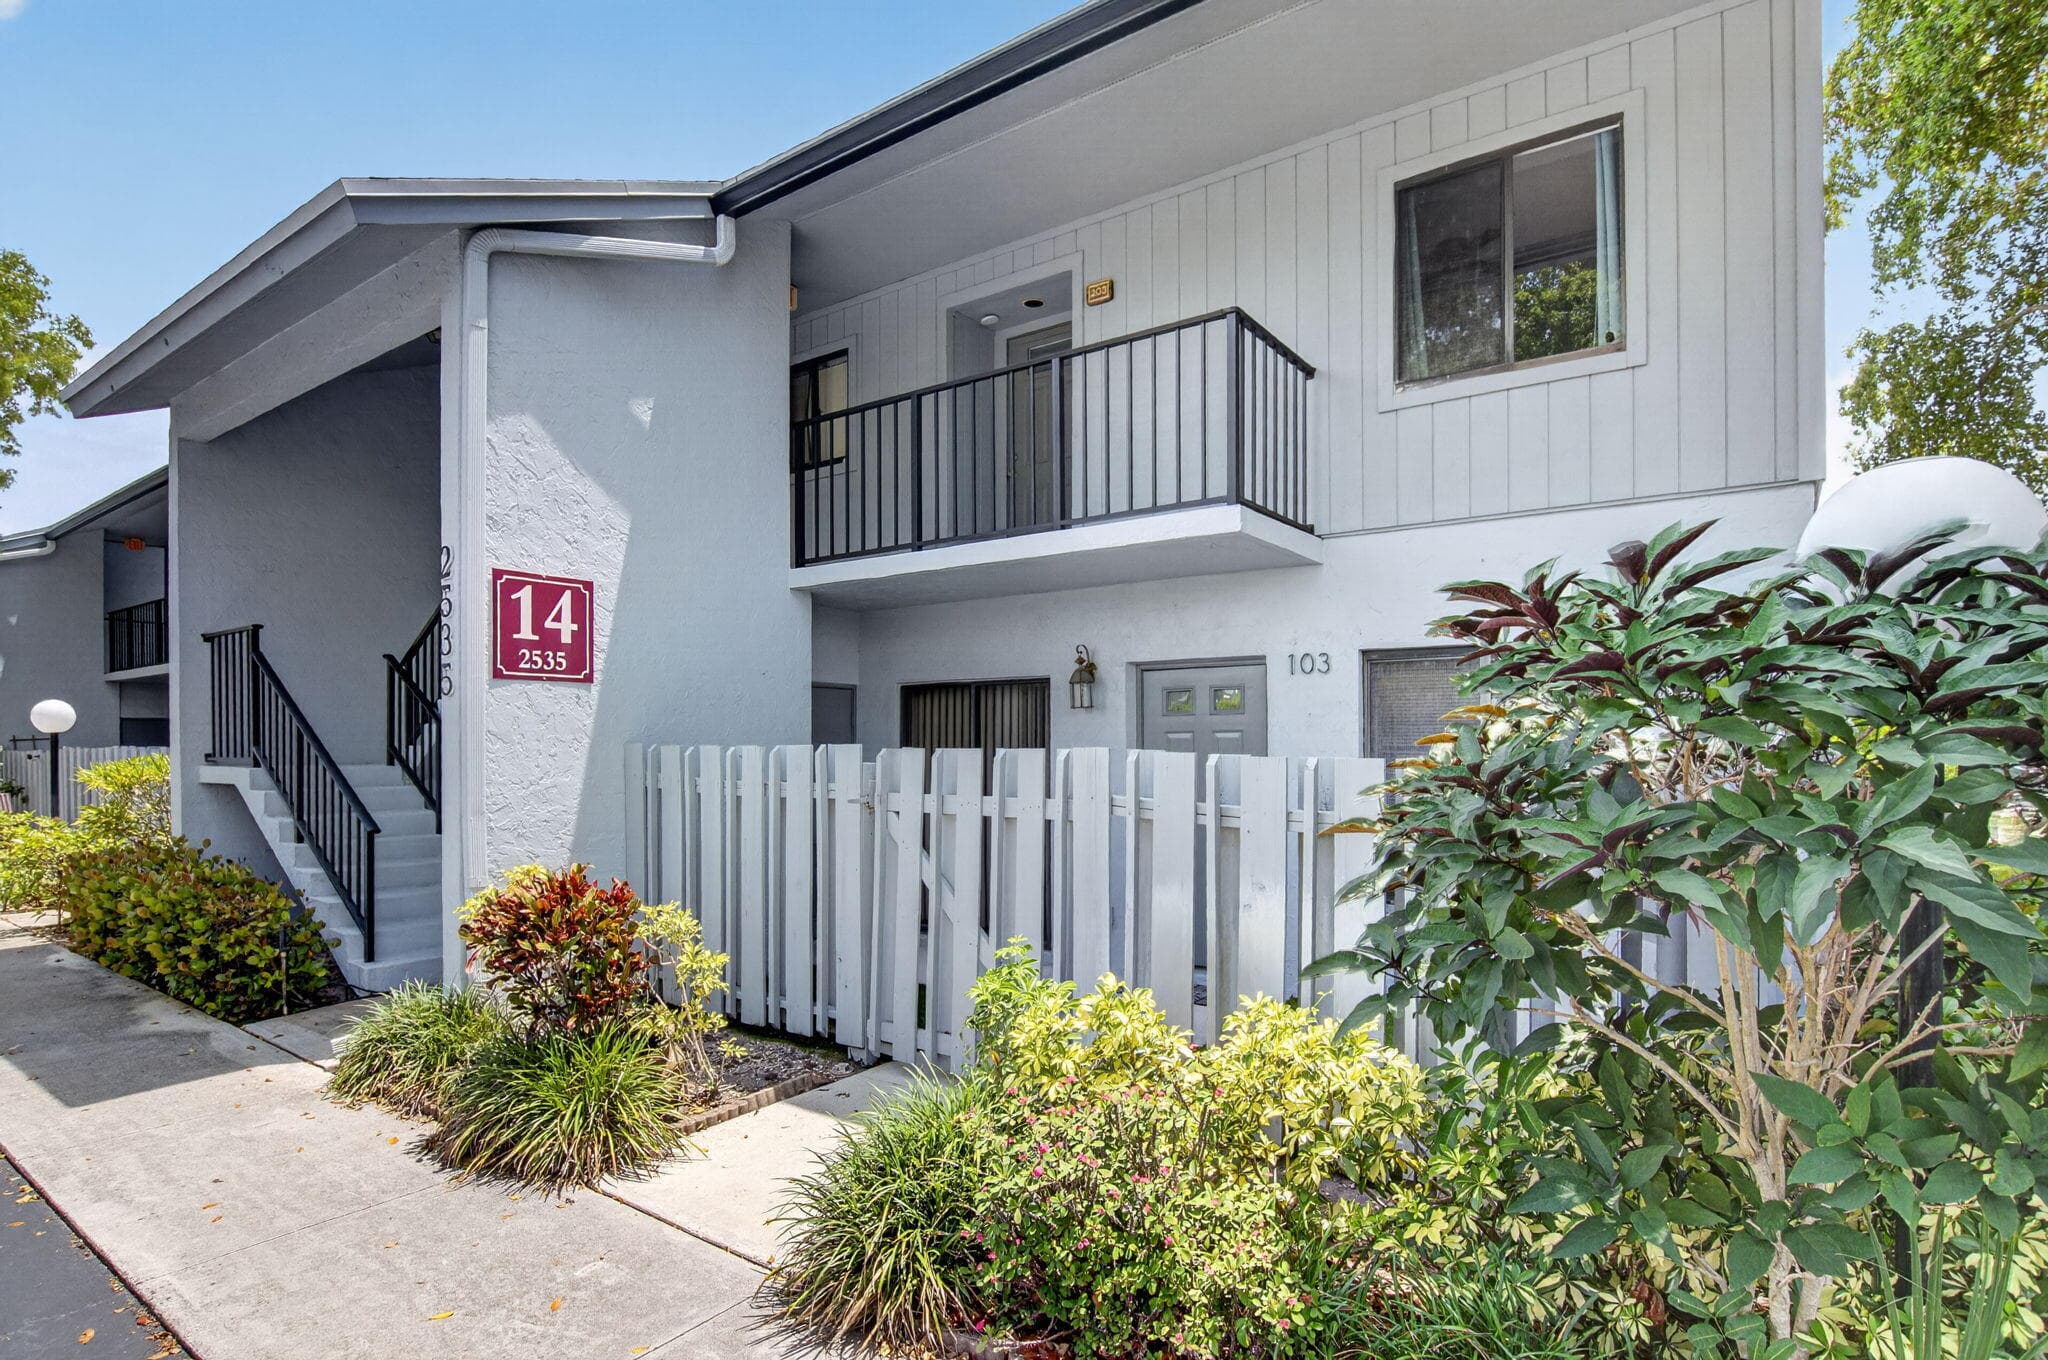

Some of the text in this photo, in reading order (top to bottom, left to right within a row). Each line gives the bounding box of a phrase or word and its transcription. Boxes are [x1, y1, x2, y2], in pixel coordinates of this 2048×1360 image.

[510, 584, 579, 644] 14
[518, 648, 567, 671] 2535
[1288, 652, 1330, 675] 103
